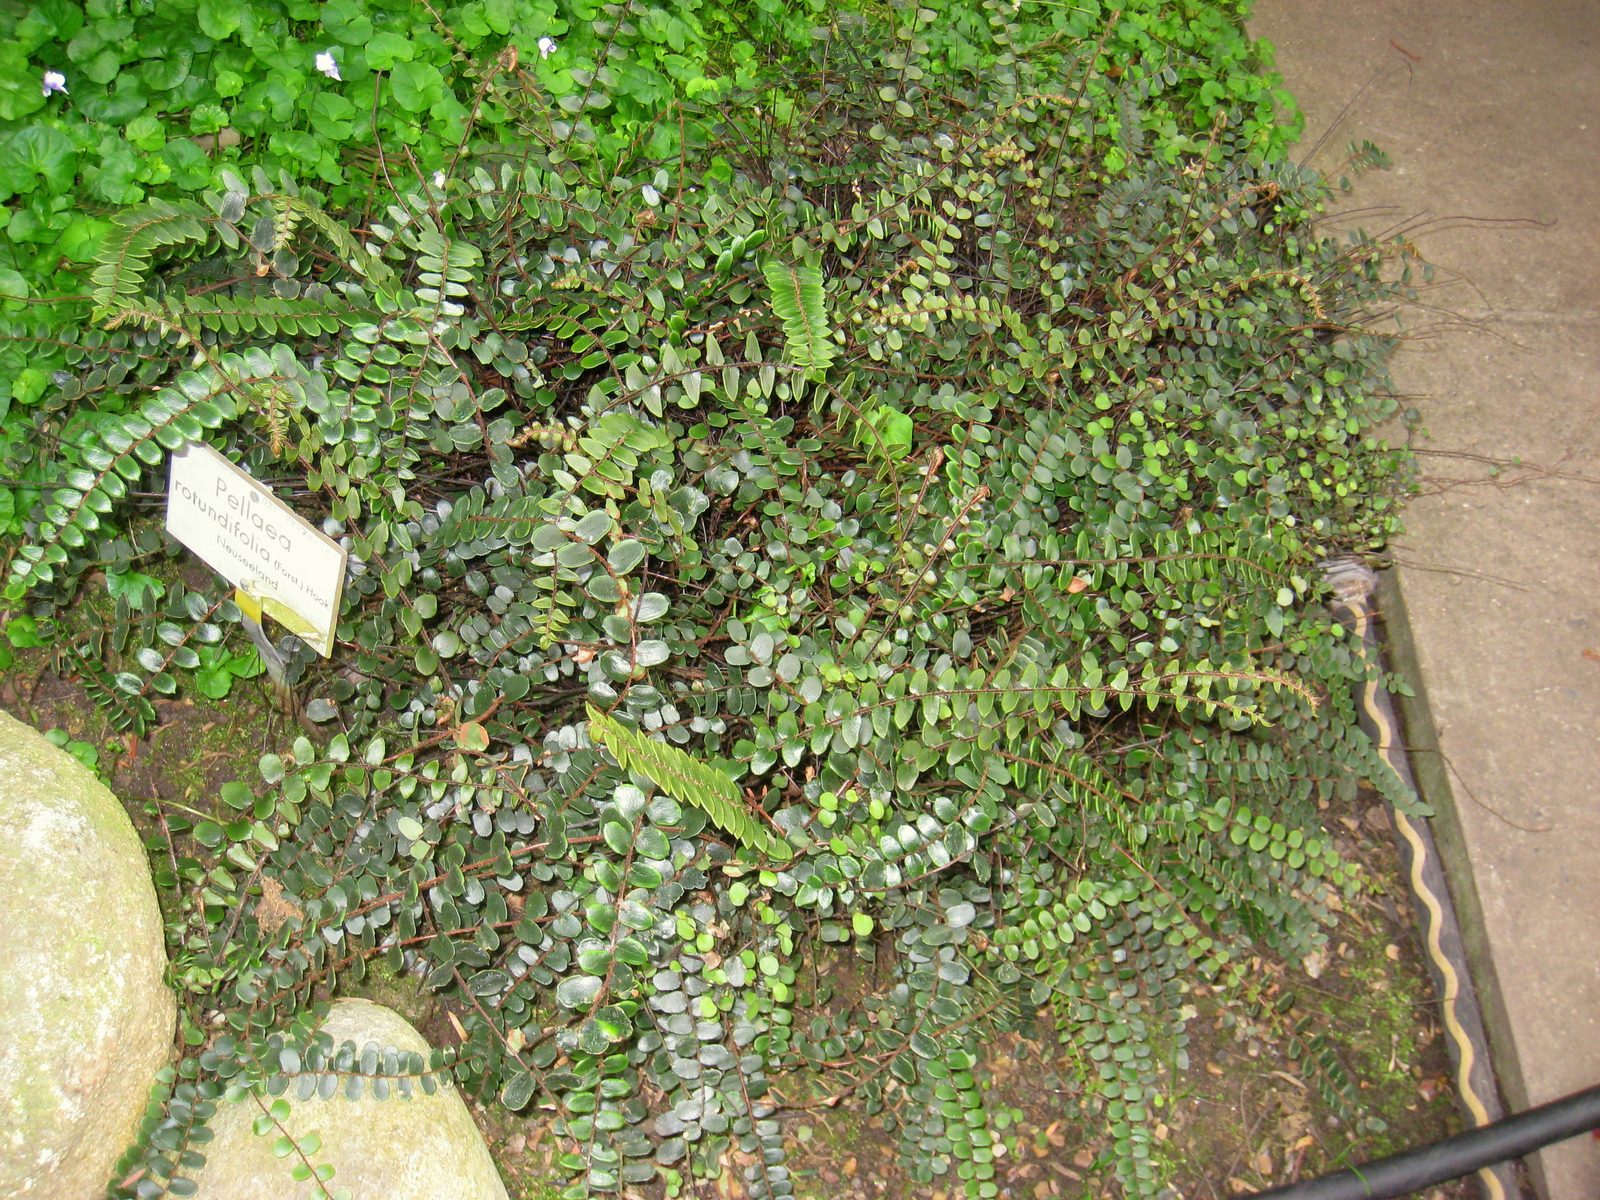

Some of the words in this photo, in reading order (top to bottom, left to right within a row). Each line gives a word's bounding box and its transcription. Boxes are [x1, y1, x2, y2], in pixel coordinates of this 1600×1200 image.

[174, 480, 270, 562] rotundifolia
[216, 477, 291, 552] Pellaea
[216, 535, 279, 590] Neuseeland
